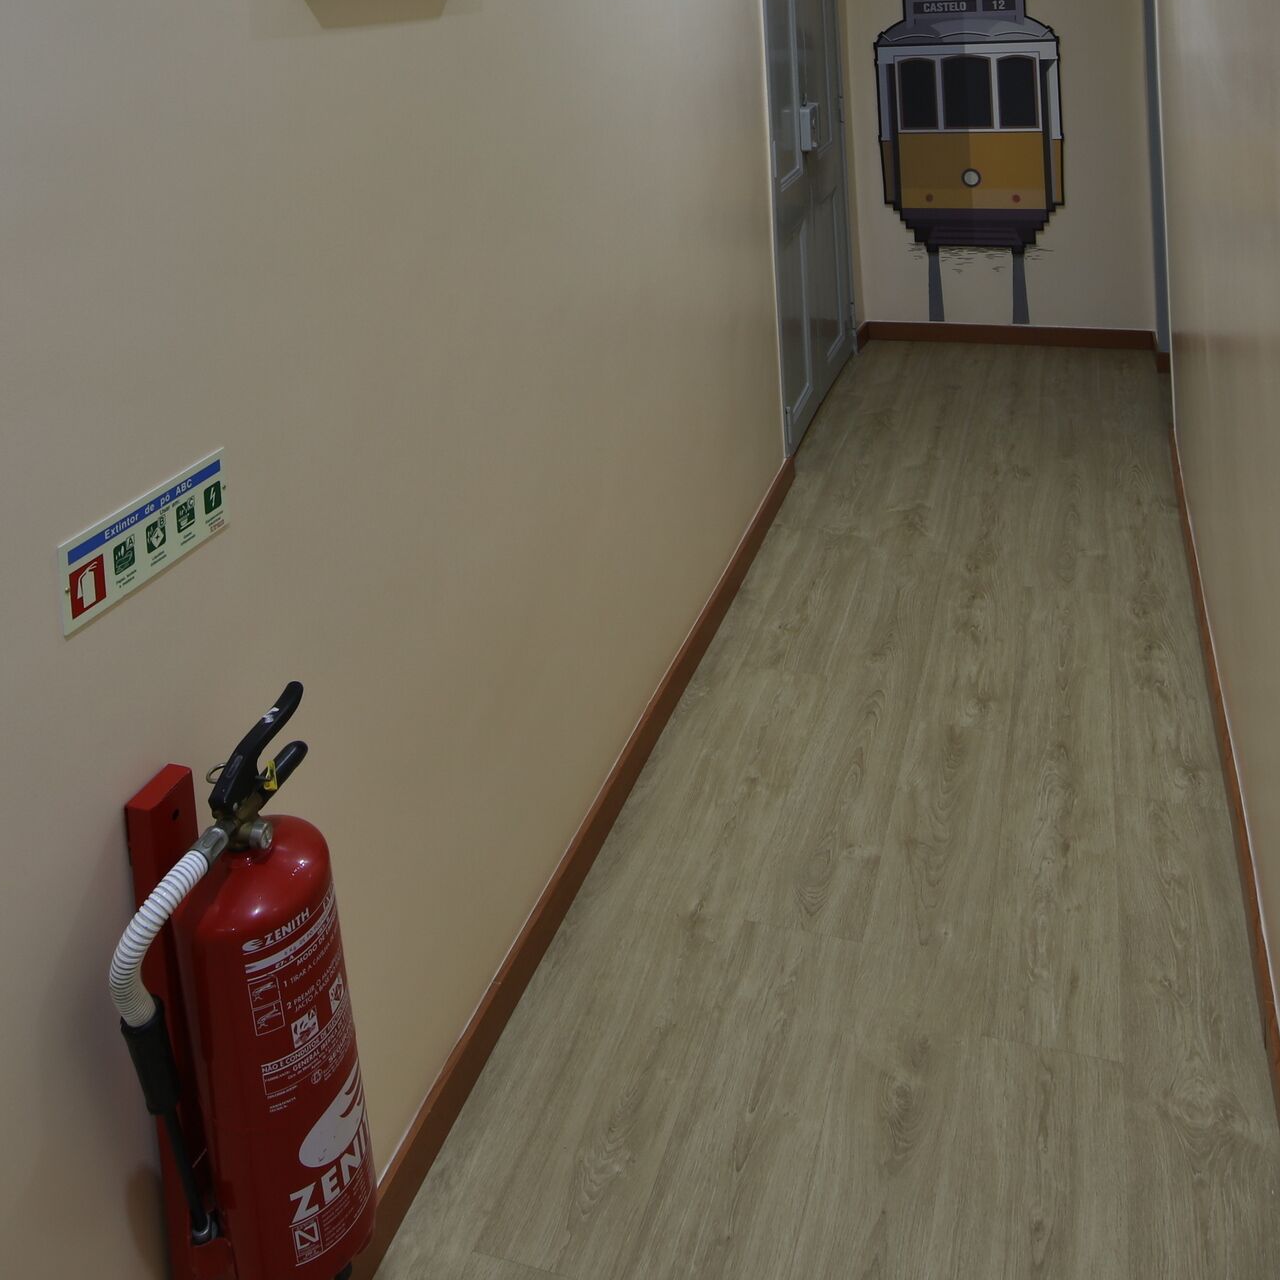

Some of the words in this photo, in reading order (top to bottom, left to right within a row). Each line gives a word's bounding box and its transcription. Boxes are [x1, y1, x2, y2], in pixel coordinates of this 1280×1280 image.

[923, 1, 967, 13] CASTELO
[991, 0, 1006, 10] 12
[104, 513, 139, 540] Extintor
[144, 504, 155, 515] de
[175, 478, 193, 497] ABC
[126, 537, 134, 548] A
[264, 907, 310, 946] ZENITH
[296, 944, 318, 966] MODO
[286, 1001, 292, 1010] 2
[292, 1049, 320, 1072] GENERAL
[290, 1116, 367, 1224] ZENI
